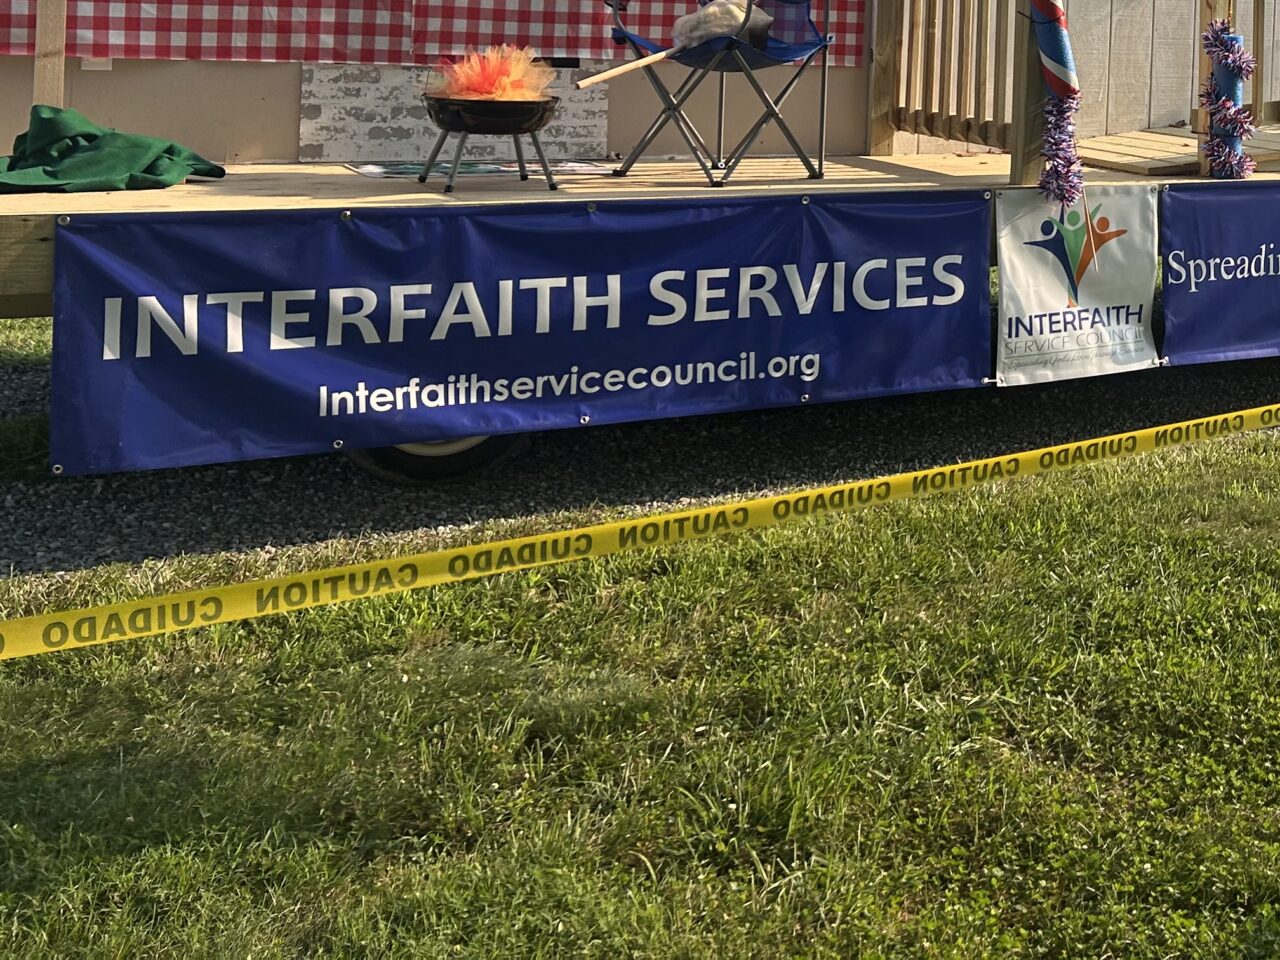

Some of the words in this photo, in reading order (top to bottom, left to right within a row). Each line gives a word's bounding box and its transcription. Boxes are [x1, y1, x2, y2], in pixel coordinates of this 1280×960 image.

[102, 274, 622, 361] INTERFAITH
[647, 254, 966, 327] SERVICES
[1007, 304, 1144, 339] INTERFAITH
[319, 350, 822, 418] Interfaithservicecouncil.org
